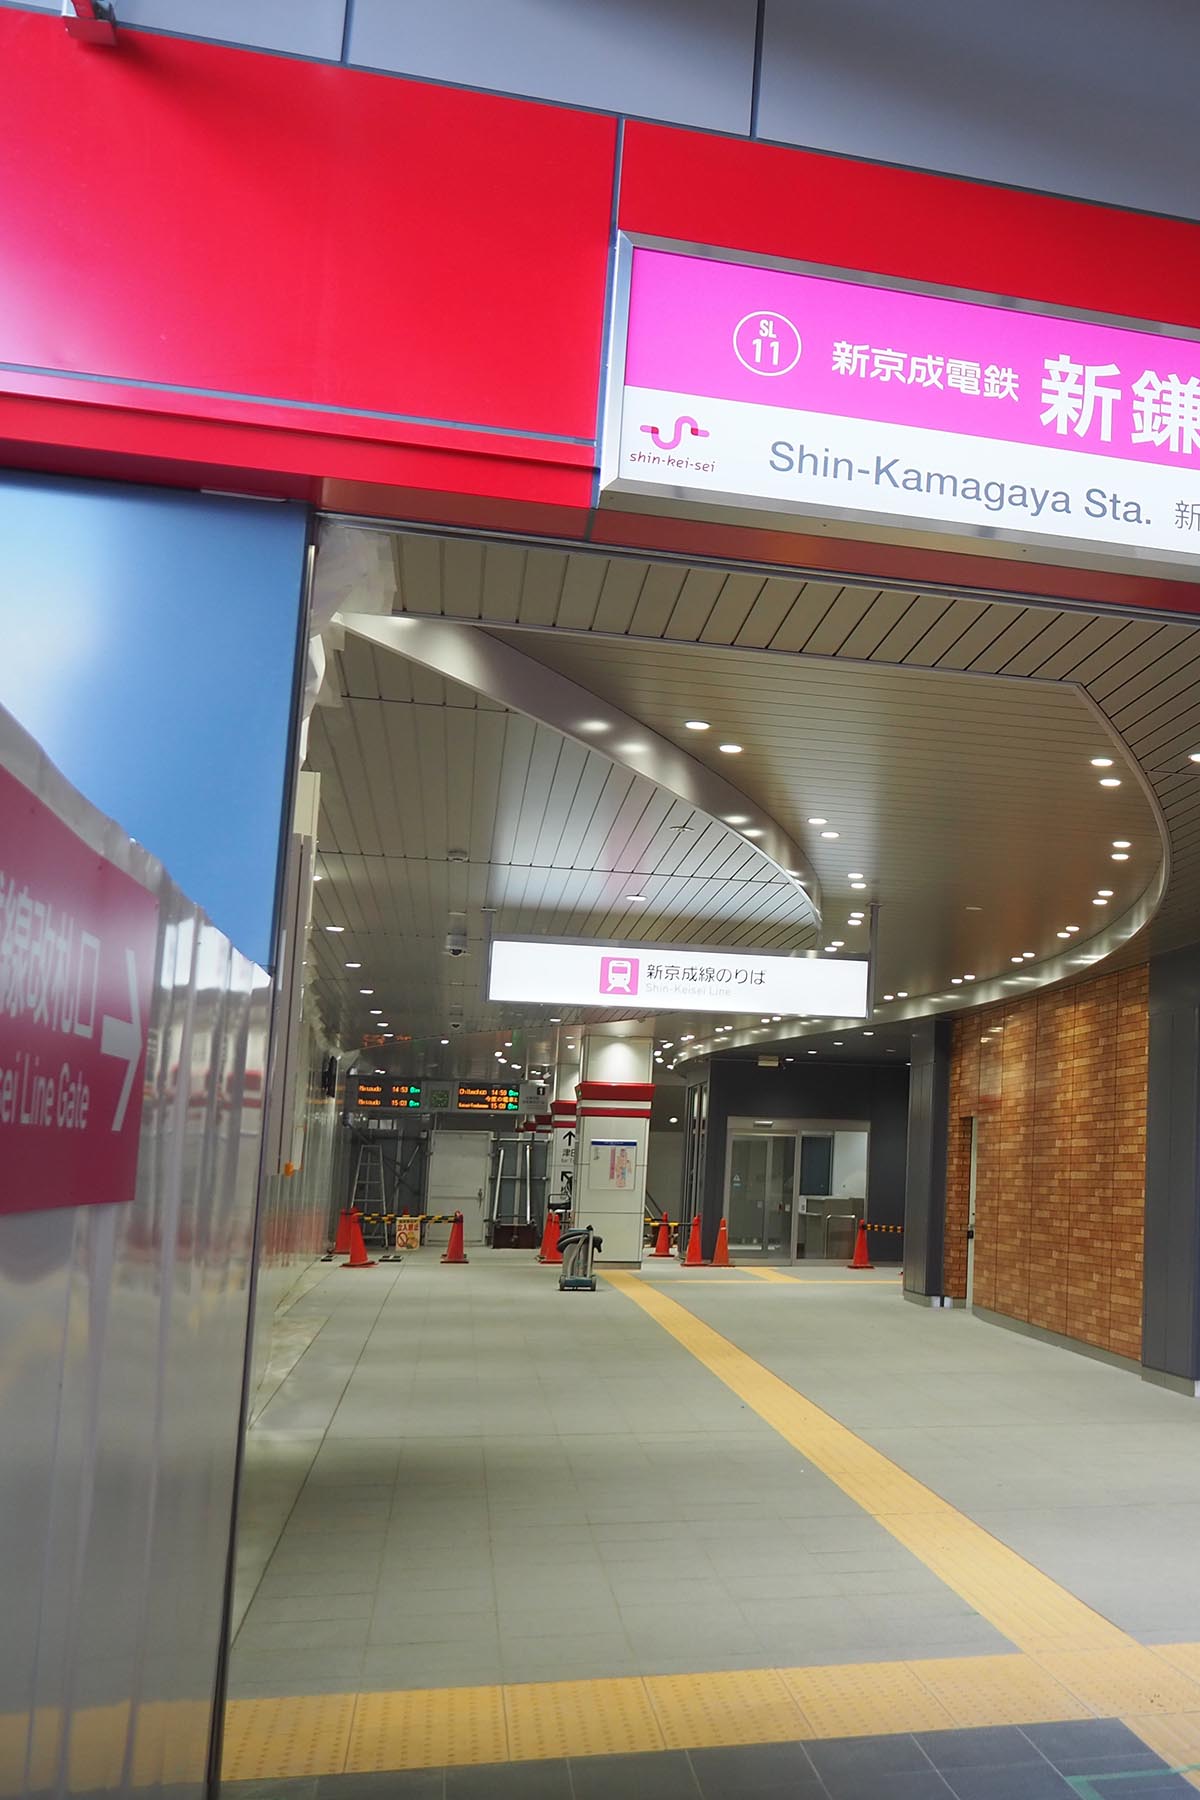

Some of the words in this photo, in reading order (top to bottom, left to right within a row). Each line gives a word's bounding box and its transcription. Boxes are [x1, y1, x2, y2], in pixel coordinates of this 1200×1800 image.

[759, 319, 777, 338] SL
[752, 338, 780, 366] 11
[831, 340, 1020, 402] 新京成電鉄
[629, 451, 716, 472] shin-kei-sei
[769, 440, 1071, 517] Shin-Kamagaya
[1084, 488, 1153, 525] Sta.
[647, 964, 767, 985] 新京成線のりば
[20, 1053, 54, 1126] Line
[56, 1062, 91, 1129] Gate
